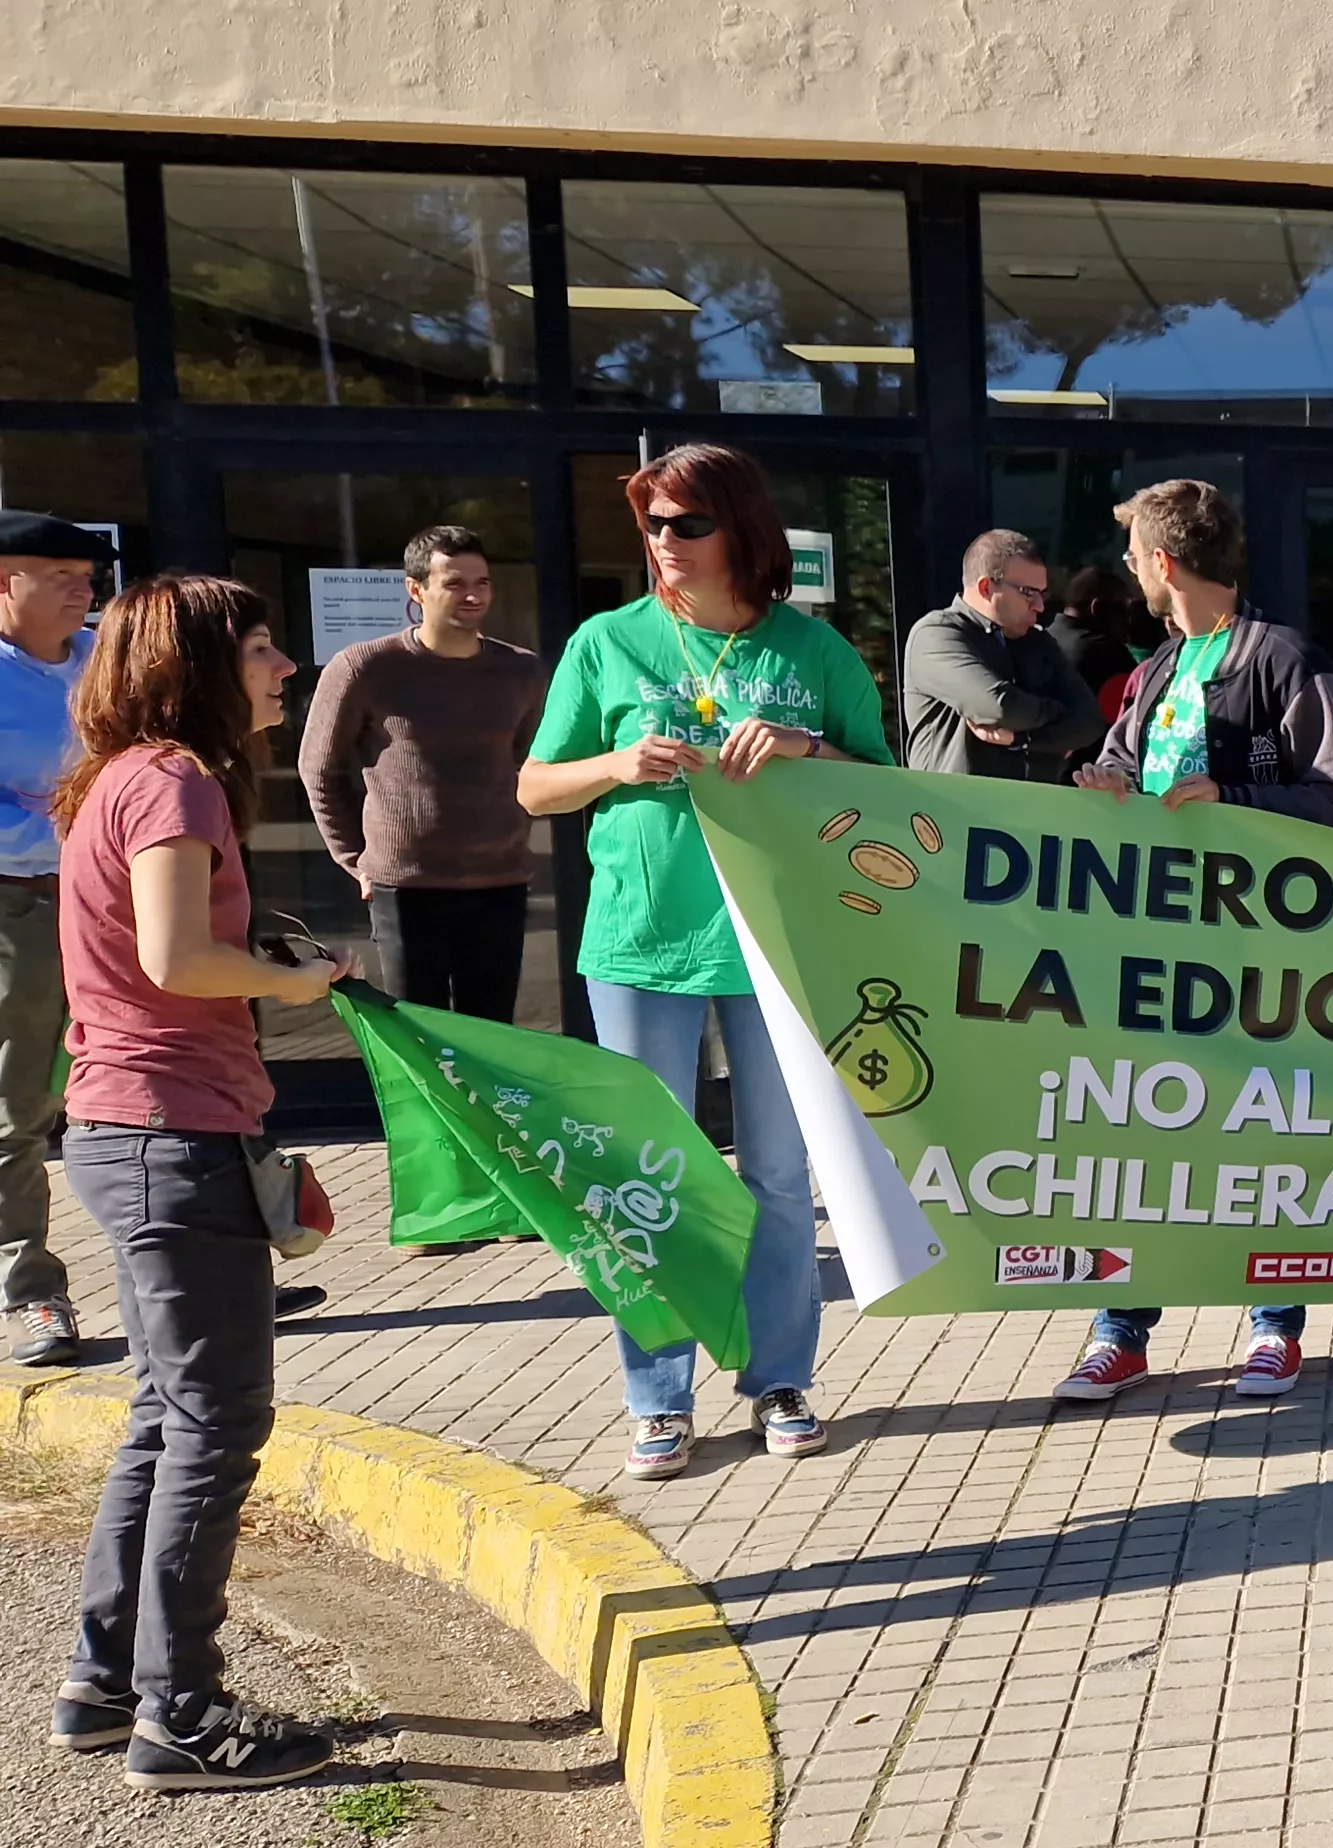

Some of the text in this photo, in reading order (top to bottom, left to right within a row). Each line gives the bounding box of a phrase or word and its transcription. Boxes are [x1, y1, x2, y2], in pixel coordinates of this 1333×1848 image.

[323, 575, 362, 584] ESPACIO
[364, 576, 391, 585] LIBRE
[955, 942, 1087, 1027] LA
[1037, 1056, 1208, 1141] ¡NO
[1222, 1066, 1332, 1137] AL
[1005, 1246, 1056, 1263] CGT
[1004, 1263, 1059, 1277] ENSEÑANZA
[207, 1736, 258, 1769] N
